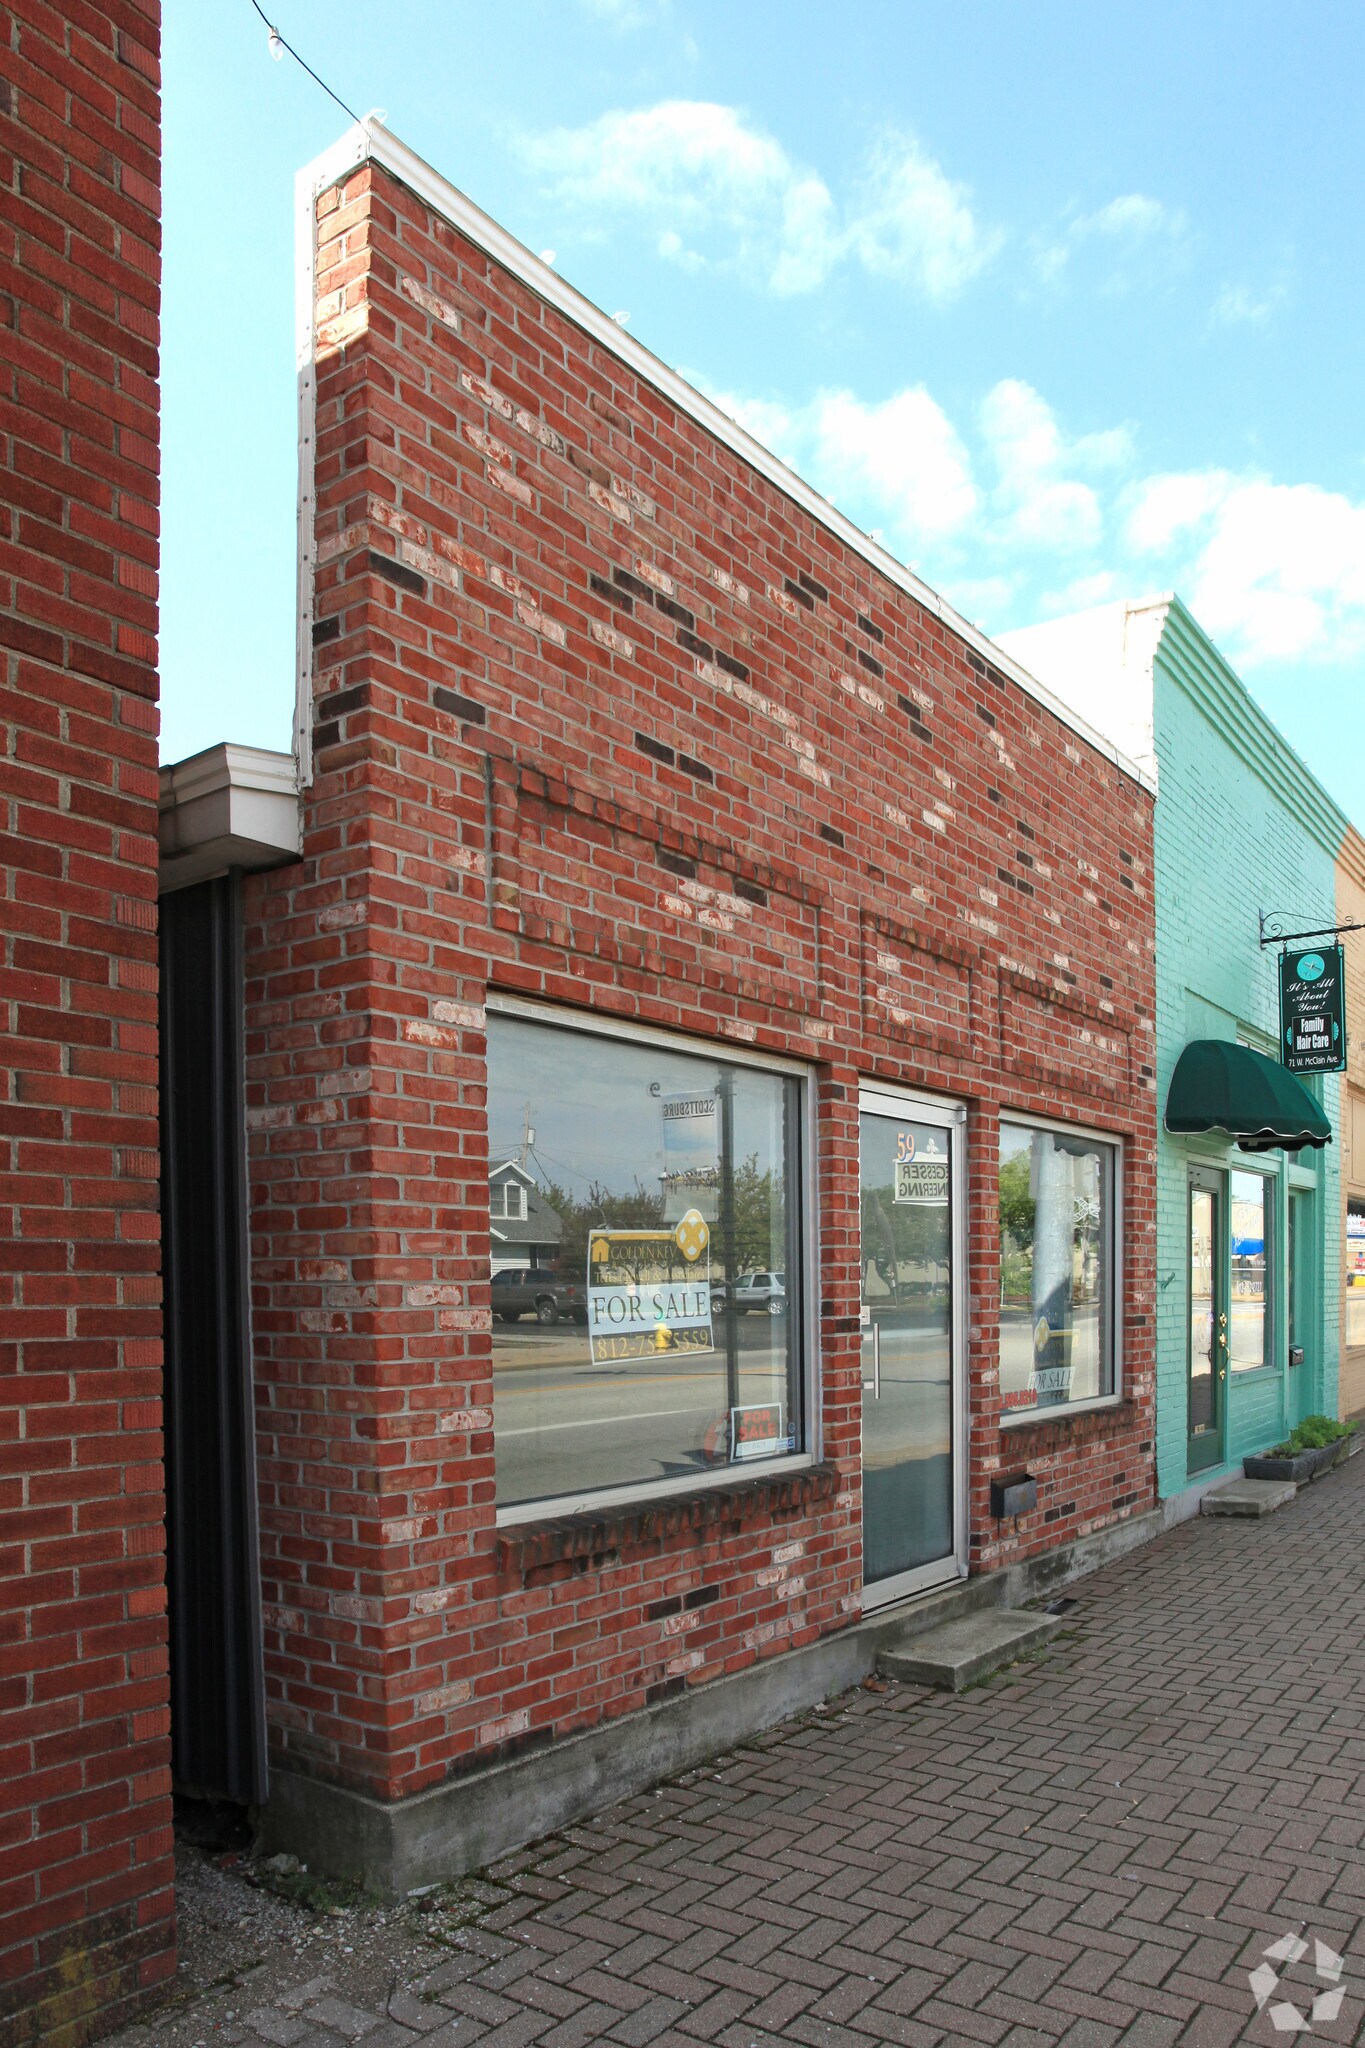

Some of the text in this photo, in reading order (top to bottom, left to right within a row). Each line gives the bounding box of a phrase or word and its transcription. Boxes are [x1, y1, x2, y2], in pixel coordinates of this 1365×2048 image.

[1286, 977, 1335, 992] It's All
[1292, 989, 1329, 1002] About
[1297, 1001, 1326, 1012] You!
[1300, 1016, 1324, 1033] Family
[1296, 1033, 1329, 1050] Hair Care
[1288, 1058, 1295, 1067] 71
[1304, 1056, 1326, 1066] McClain
[897, 1130, 916, 1163] 59
[610, 1243, 678, 1260] GOLDEN KEY
[592, 1291, 709, 1325] FOR SALE
[597, 1329, 709, 1360] 812-75-5559
[1029, 1369, 1073, 1391] FOR SALE
[743, 1409, 771, 1425] FOR
[739, 1421, 778, 1441] SALE
